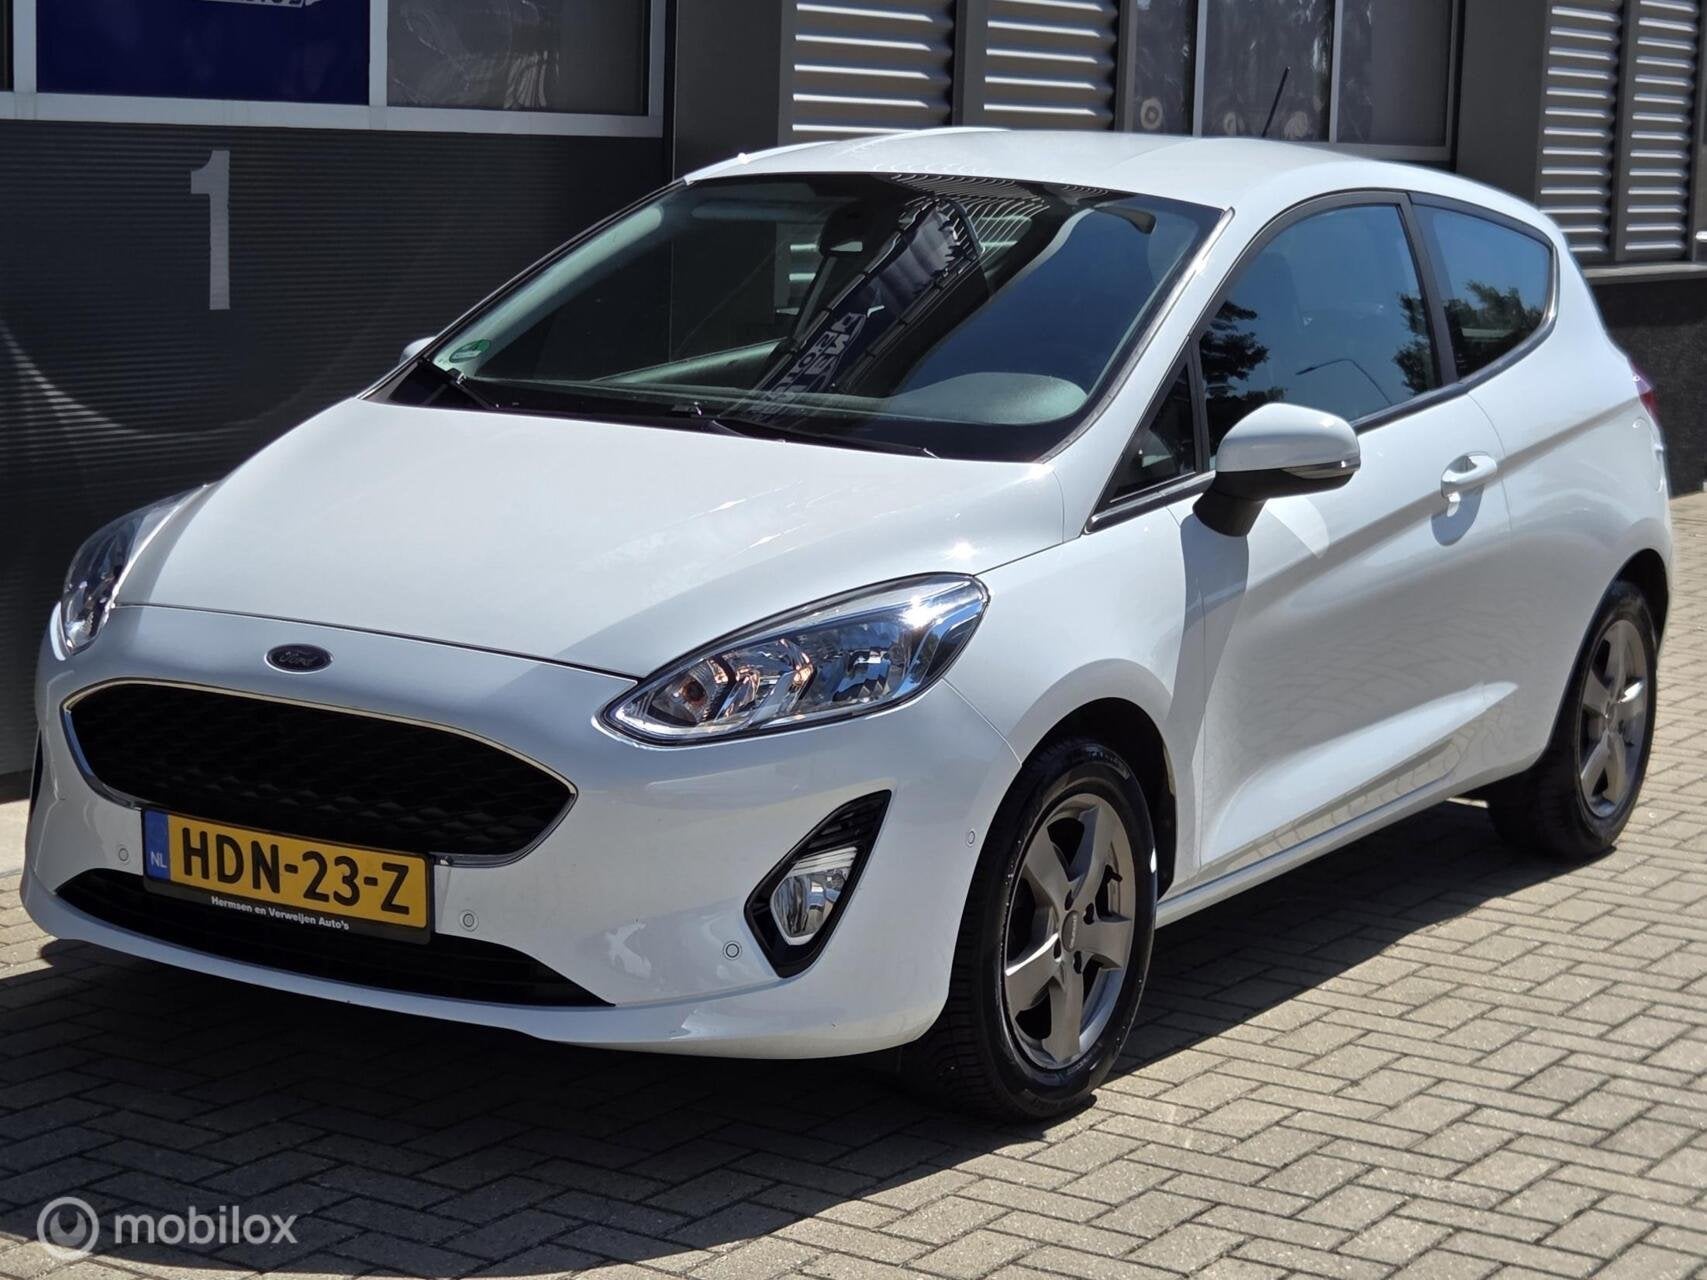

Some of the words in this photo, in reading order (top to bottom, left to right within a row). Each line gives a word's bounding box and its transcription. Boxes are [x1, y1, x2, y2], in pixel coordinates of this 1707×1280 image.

[191, 150, 230, 310] 1
[276, 647, 319, 666] Ford
[150, 851, 168, 869] NL
[181, 827, 410, 916] HDN-23-Z
[211, 894, 253, 914] Hermsen
[254, 906, 267, 917] en
[268, 906, 317, 926] Verweijen
[318, 916, 350, 931] Auto's
